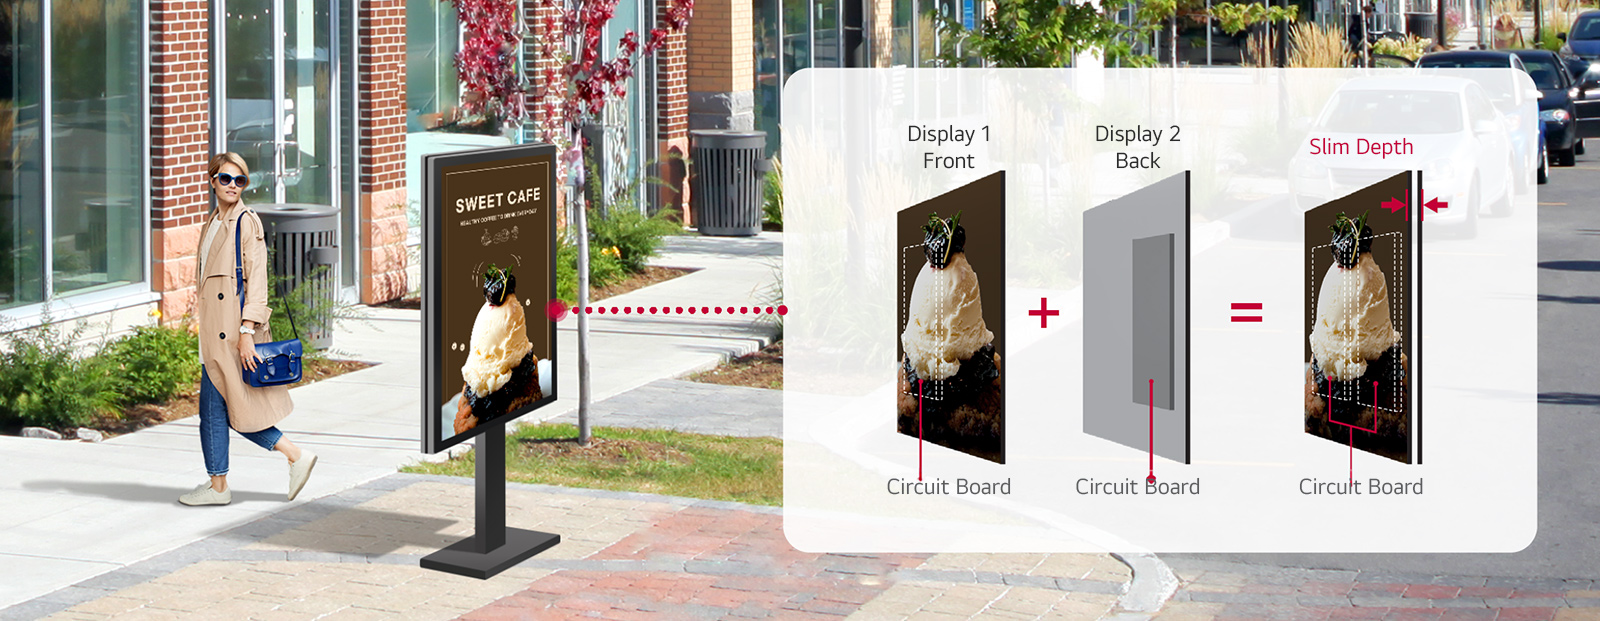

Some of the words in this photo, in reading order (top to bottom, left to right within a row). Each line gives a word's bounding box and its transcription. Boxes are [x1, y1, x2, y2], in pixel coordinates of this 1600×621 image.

[456, 192, 504, 214] SWEET
[507, 187, 541, 205] CAFE
[460, 217, 481, 227] HEALTHY
[481, 214, 498, 223] COFFEE
